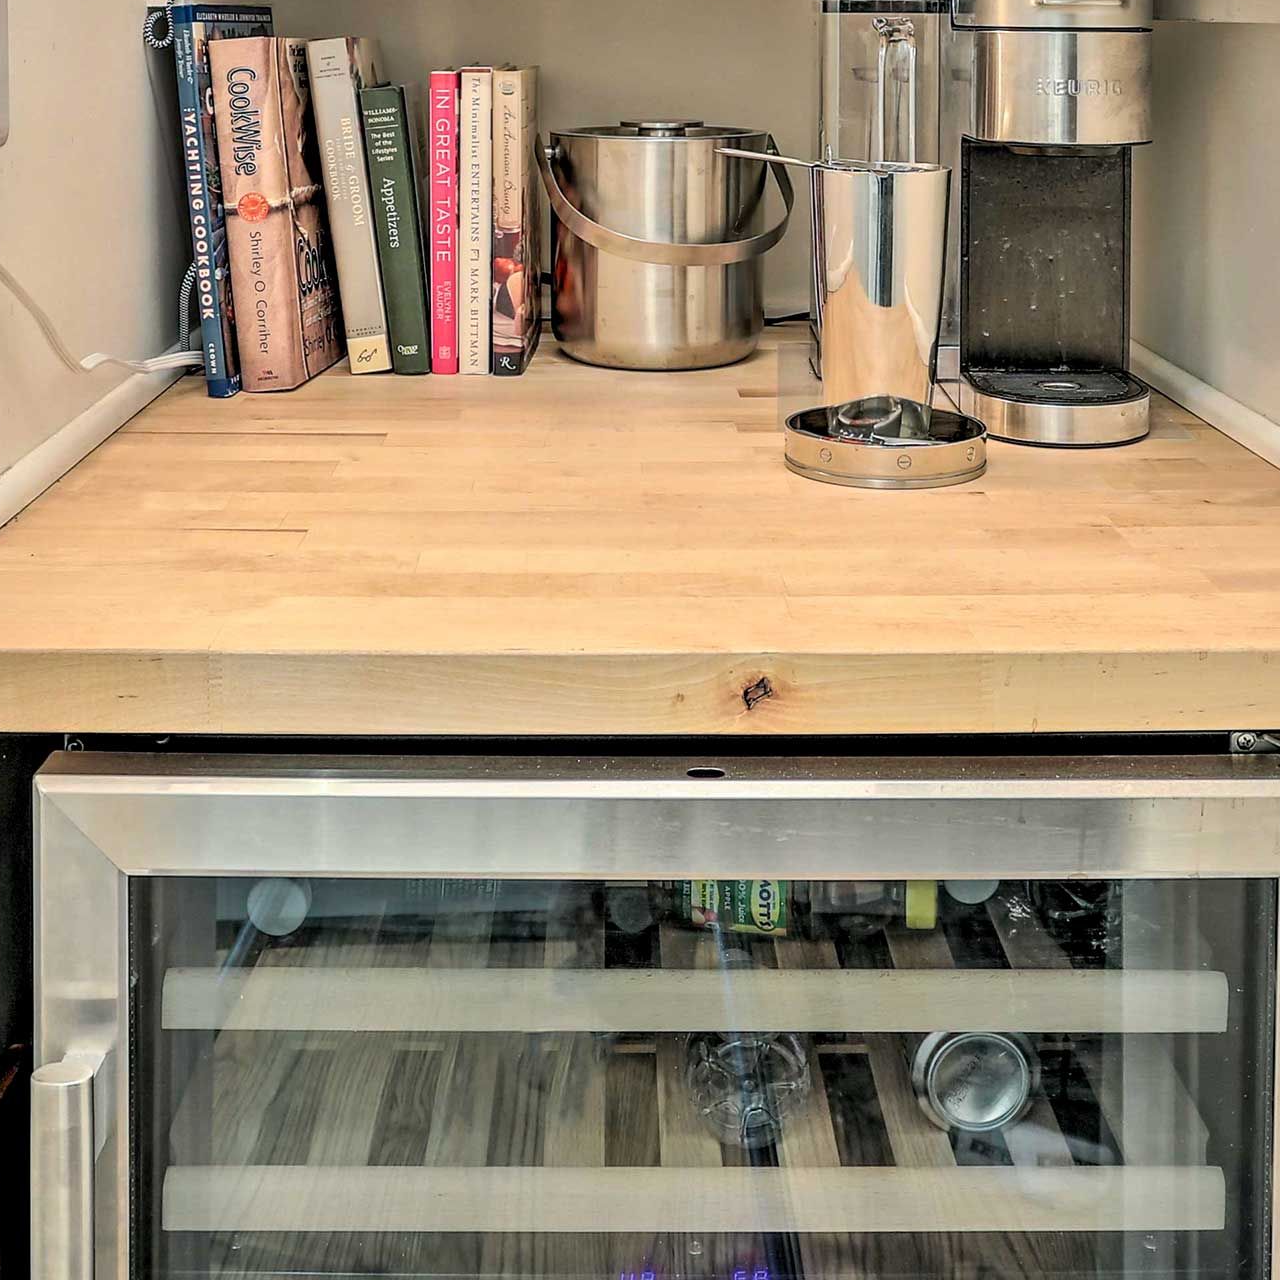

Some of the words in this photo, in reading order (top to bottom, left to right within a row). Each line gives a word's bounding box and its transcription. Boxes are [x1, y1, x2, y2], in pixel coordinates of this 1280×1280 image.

[435, 89, 451, 109] IN
[471, 77, 481, 94] The
[1035, 78, 1122, 97] KEURIG
[227, 66, 261, 176] CookWise
[471, 97, 481, 159] Minimalist
[503, 105, 516, 124] An
[184, 112, 203, 210] YACHTING
[325, 139, 342, 201] COOKBOOK
[340, 117, 356, 160] BRIDE
[348, 175, 365, 226] GROOM
[435, 119, 451, 187] GREAT
[503, 126, 516, 177] American
[382, 177, 400, 249] Appetizers
[470, 163, 480, 242] ENTERTAINS
[249, 231, 264, 276] Shirley
[435, 199, 451, 262] TASTE
[193, 215, 214, 319] COOKBOOK
[254, 280, 266, 296] O.
[470, 268, 480, 304] MARK
[436, 285, 444, 320] LAUDER
[443, 281, 451, 314] EVELYN
[255, 299, 272, 354] Corriher
[470, 309, 480, 367] BITTMAN
[208, 342, 216, 374] CROWN
[738, 901, 746, 923] Juice
